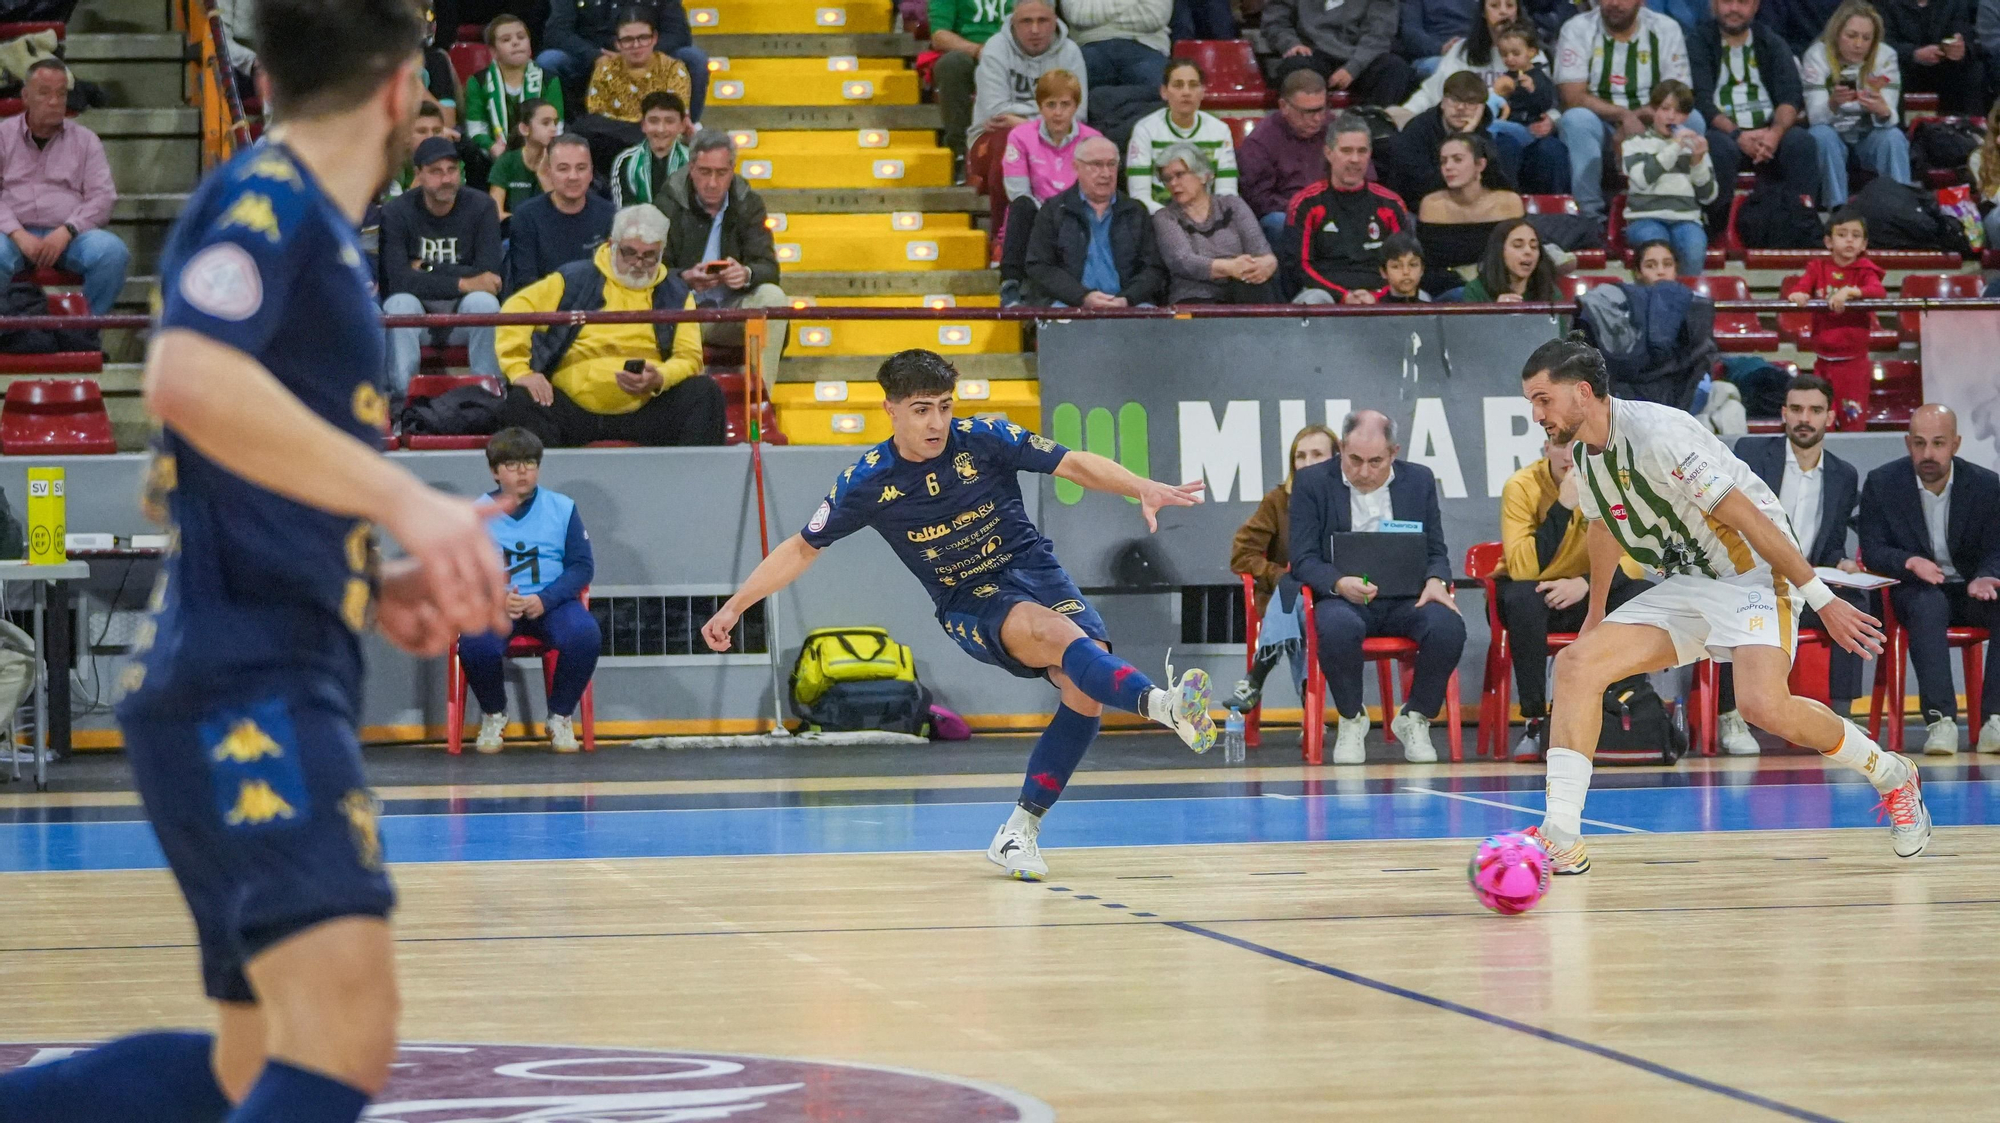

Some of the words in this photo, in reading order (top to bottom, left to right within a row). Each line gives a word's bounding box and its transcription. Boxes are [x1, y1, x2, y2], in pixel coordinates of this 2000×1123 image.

[32, 483, 47, 493] SV
[925, 472, 941, 497] 6
[907, 523, 951, 543] Celta
[934, 553, 982, 575] reganosa
